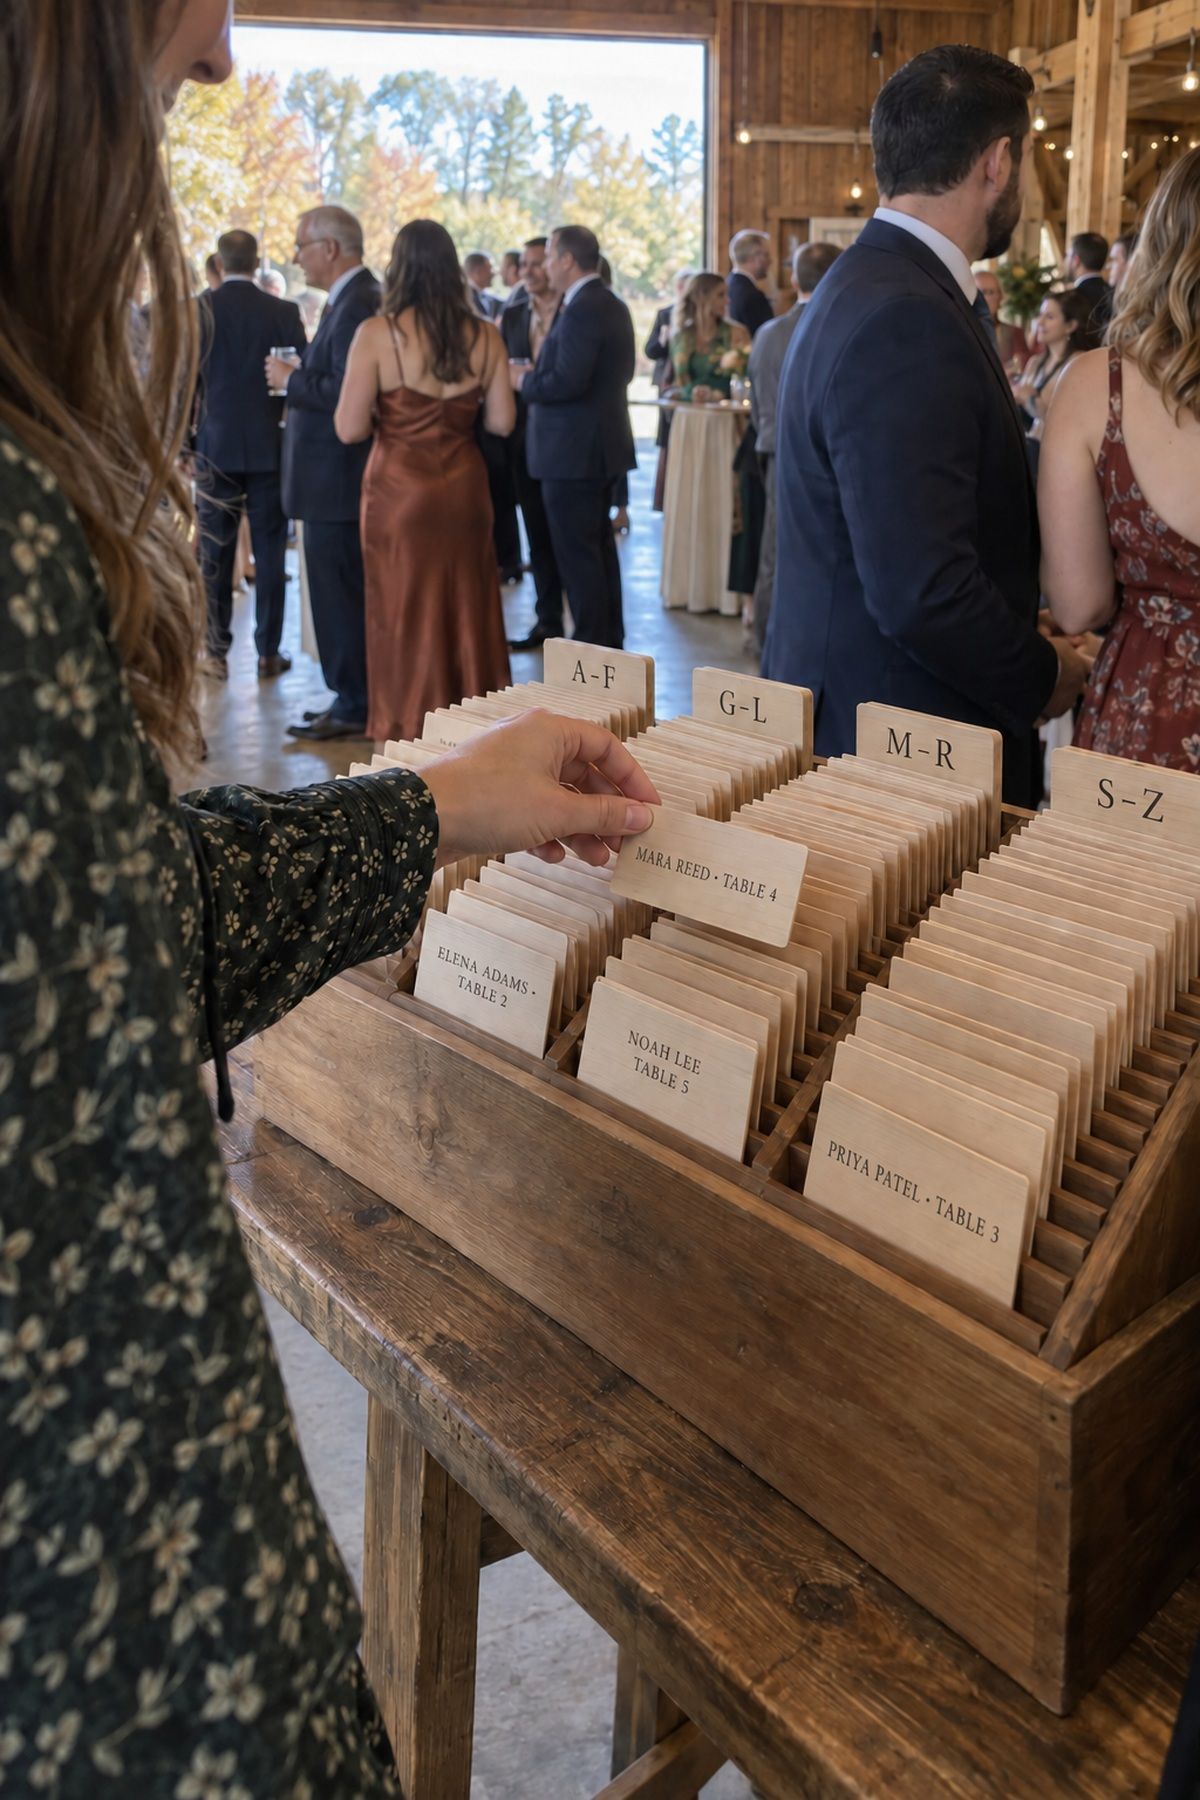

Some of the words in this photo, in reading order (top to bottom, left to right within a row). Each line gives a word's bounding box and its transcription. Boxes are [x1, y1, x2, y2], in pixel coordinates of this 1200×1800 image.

[635, 846, 672, 870] MARA
[675, 858, 711, 881] REED
[723, 873, 767, 900] TABLE
[769, 888, 778, 902] 4
[438, 946, 478, 974] ELENA
[482, 966, 529, 995] ADAMS
[457, 975, 498, 1003] TABLE
[500, 994, 508, 1008] 2
[627, 1030, 671, 1061] NOAH
[674, 1050, 702, 1075] LEE
[634, 1056, 678, 1090] TABLE
[827, 1140, 870, 1176] PRIYA
[874, 1164, 921, 1203] PATEL
[936, 1195, 986, 1237] TABLE
[990, 1225, 1000, 1243] 3
